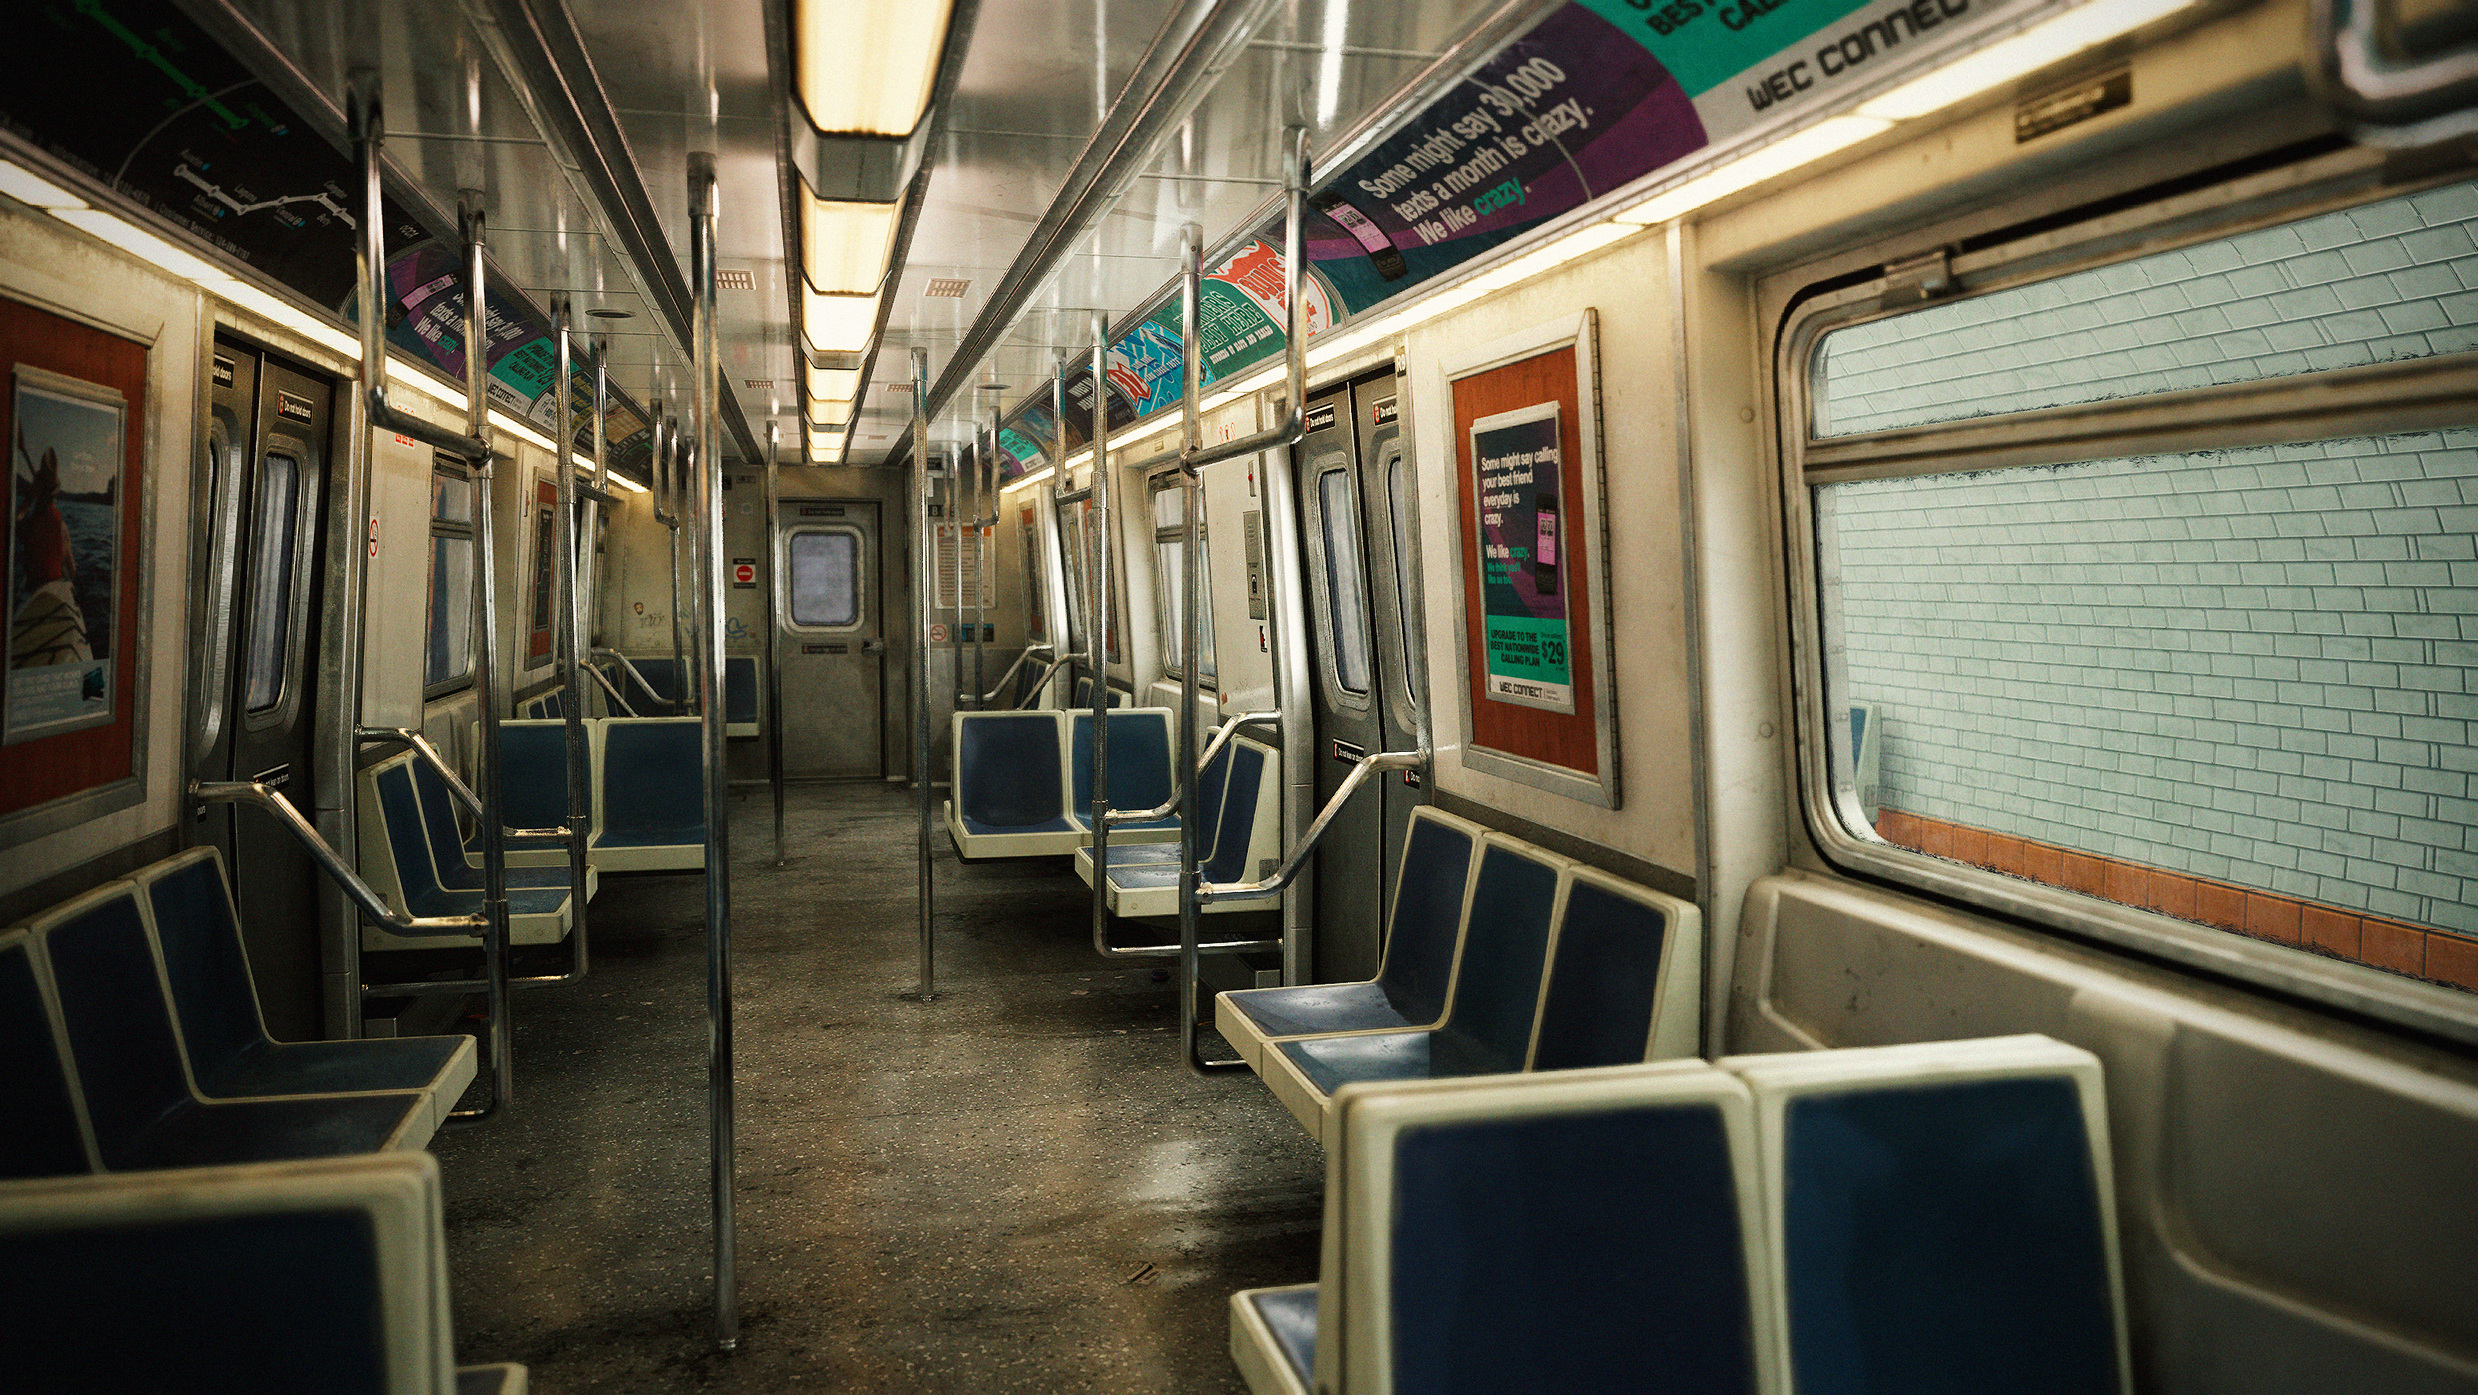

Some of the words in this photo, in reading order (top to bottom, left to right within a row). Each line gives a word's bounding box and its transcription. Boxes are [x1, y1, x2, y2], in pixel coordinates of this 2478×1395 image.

[1645, 0, 1714, 36] BES
[1746, 60, 1814, 112] WEC
[1358, 160, 1417, 200] Some
[1404, 127, 1467, 174] might
[1452, 106, 1502, 140] say
[1479, 57, 1566, 117] 30,000
[1391, 189, 1440, 223] texts
[1432, 181, 1451, 201] a
[1443, 145, 1509, 194] month
[1492, 135, 1529, 161] is
[1522, 97, 1594, 147] crazy.
[1413, 218, 1448, 246] We
[1438, 204, 1477, 233] like
[1473, 177, 1532, 216] crazy.
[1220, 302, 1264, 336] HERE
[1482, 457, 1500, 471] Some
[1501, 452, 1520, 471] might
[1520, 452, 1533, 468] say
[1534, 446, 1559, 464] calling
[1482, 476, 1497, 492] your
[1497, 473, 1513, 487] best
[1513, 469, 1533, 485] friend
[1483, 491, 1512, 508] everyday
[1513, 489, 1520, 504] is
[1484, 512, 1504, 527] crazy.
[1485, 544, 1497, 559] We
[1497, 544, 1509, 559] like
[1490, 629, 1515, 640] UPGRADE
[1517, 631, 1525, 641] TO
[1525, 632, 1537, 642] THE
[1490, 641, 1503, 651] BEST
[1505, 642, 1539, 655] NATIONWIDE
[1501, 653, 1523, 665] CALLING
[1525, 656, 1540, 667] PLAN
[1499, 681, 1512, 693] WEC
[1513, 684, 1543, 698] CONNECT
